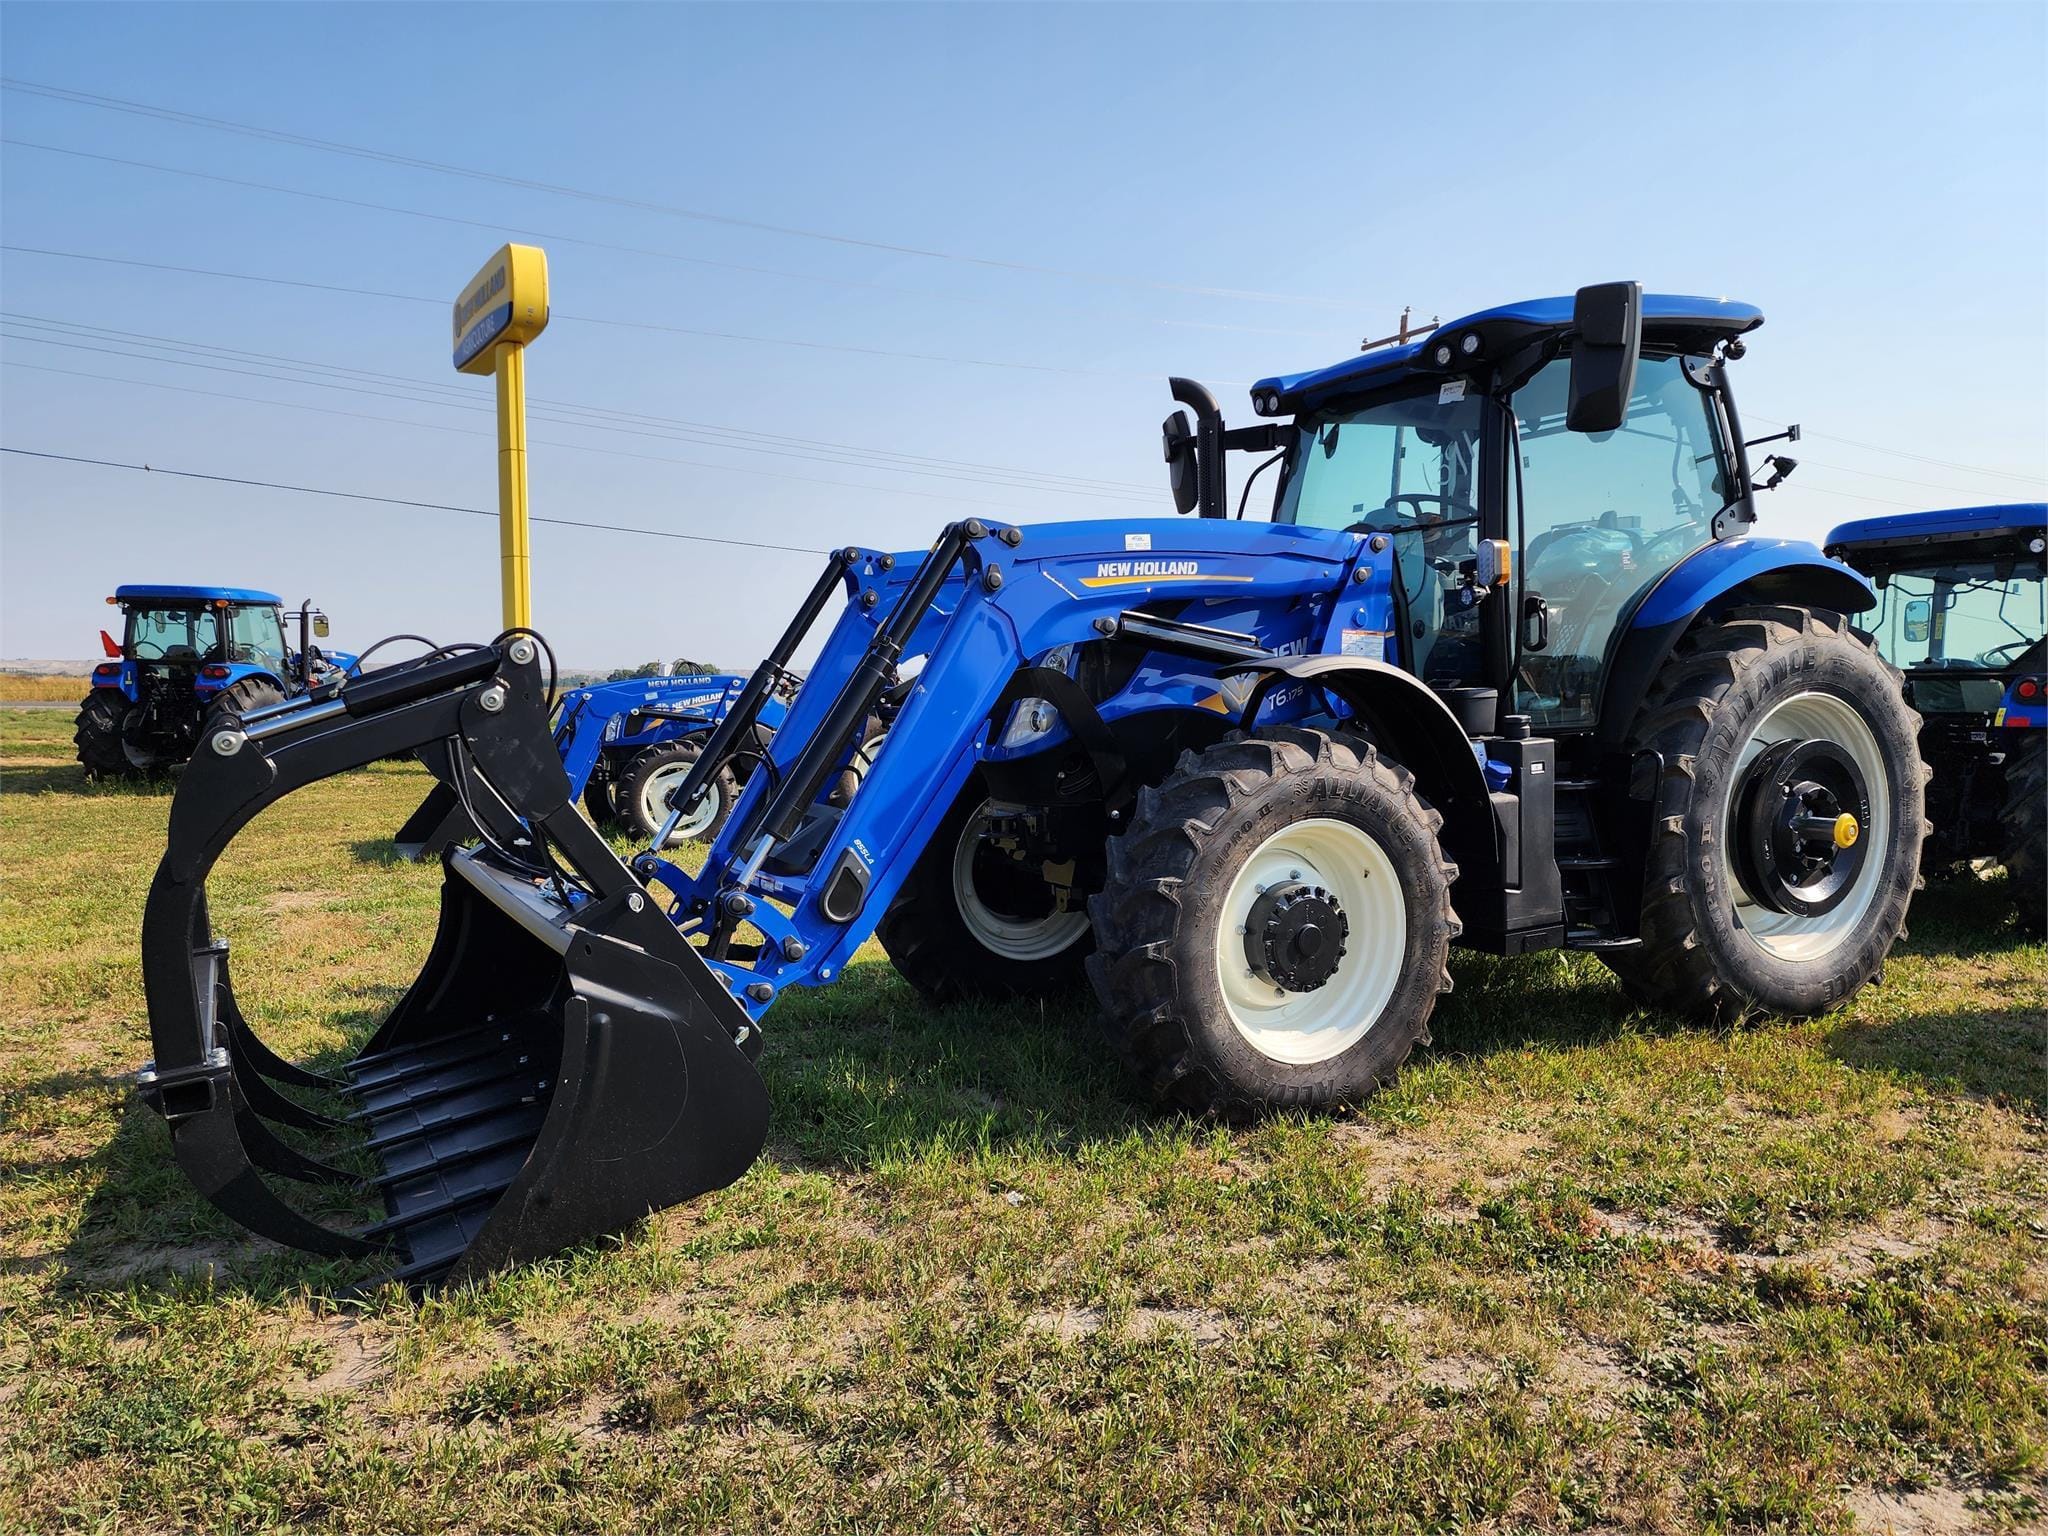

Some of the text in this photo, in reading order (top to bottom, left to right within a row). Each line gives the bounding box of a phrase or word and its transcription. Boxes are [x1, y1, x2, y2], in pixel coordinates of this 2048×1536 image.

[1097, 561, 1199, 578] NEW HOLLAND
[1272, 636, 1309, 658] EW
[647, 676, 712, 689] NEW HOLLAND
[672, 692, 724, 710] NEW HOLLAN
[1268, 684, 1304, 711] T6.175
[1305, 776, 1416, 846] ALLIANCE
[853, 838, 875, 865] 855LA
